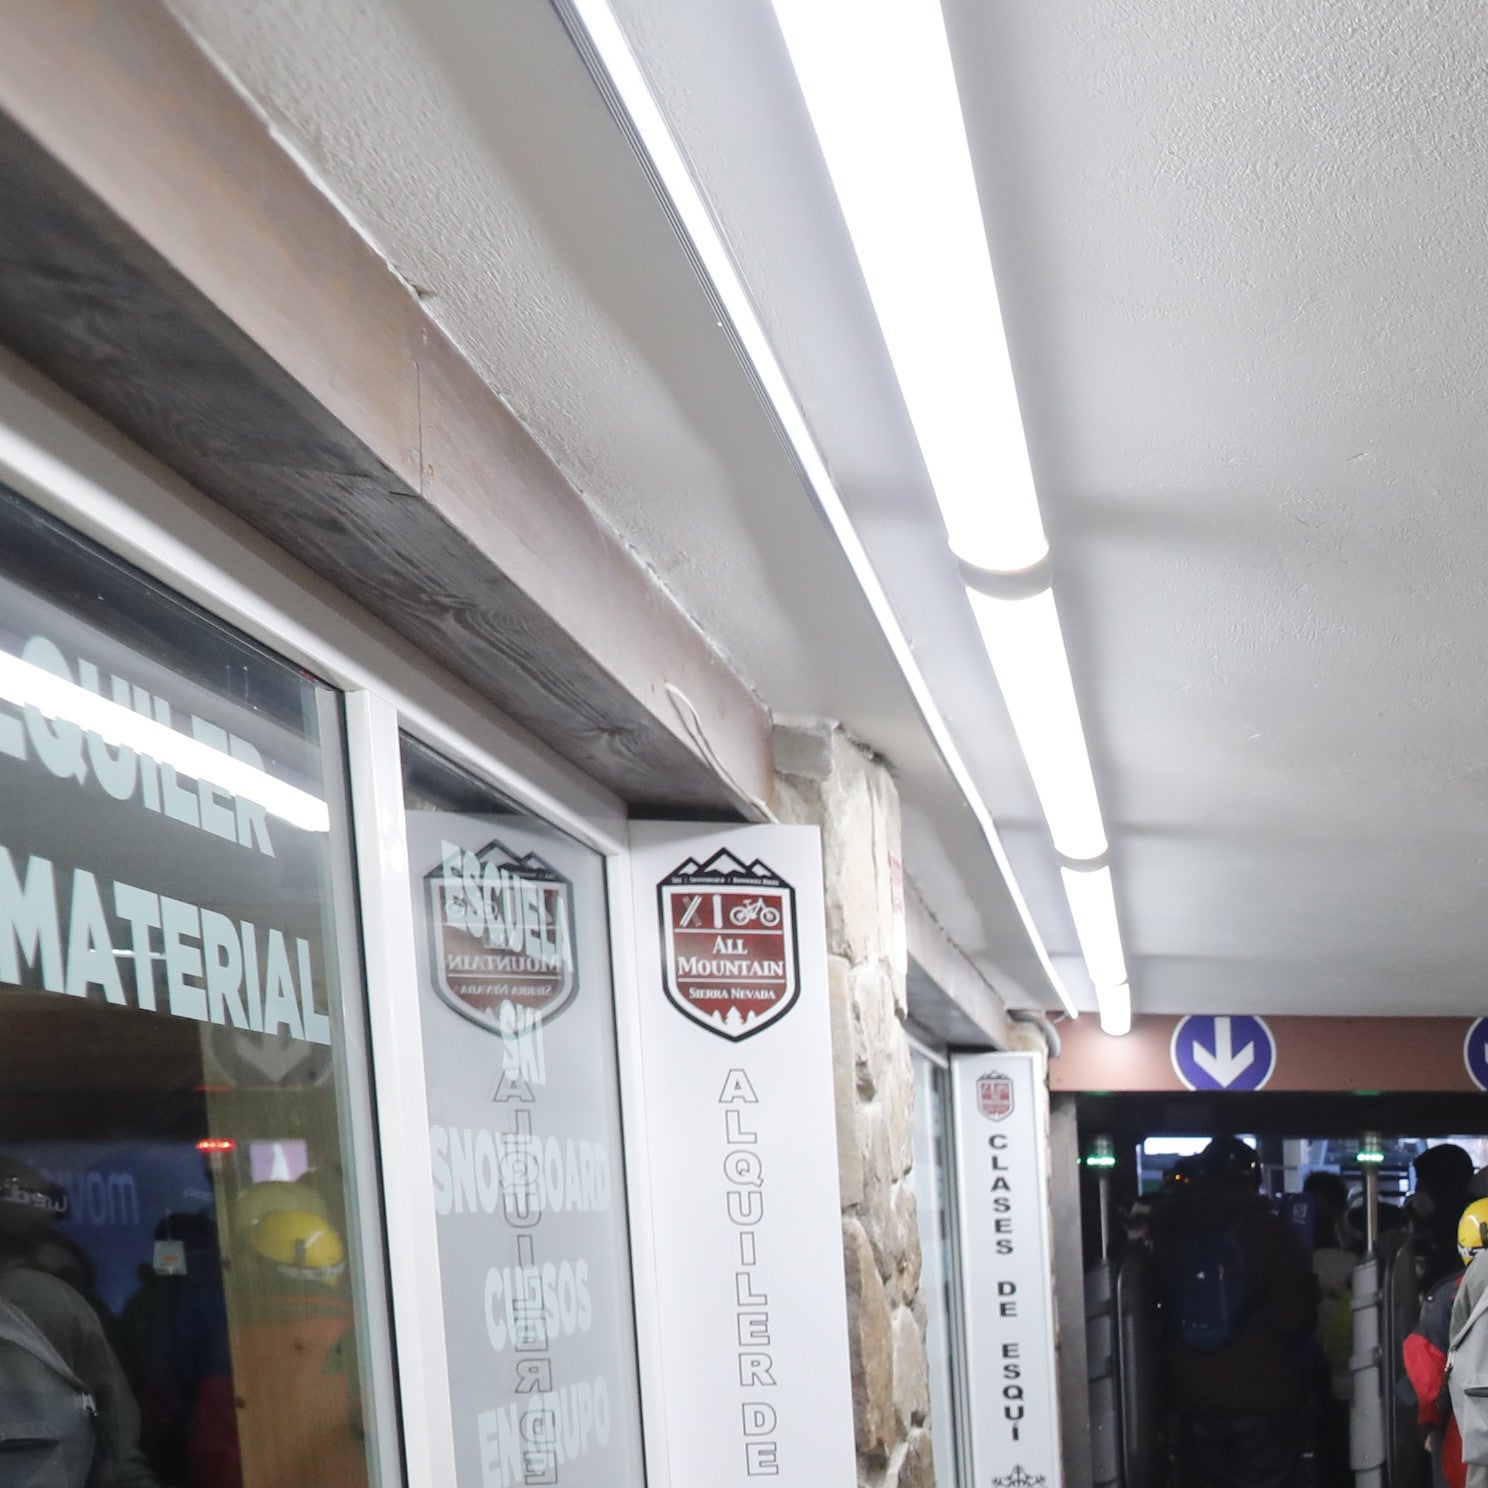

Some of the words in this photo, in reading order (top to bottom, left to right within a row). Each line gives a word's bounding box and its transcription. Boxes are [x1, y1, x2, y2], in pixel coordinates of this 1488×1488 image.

[441, 840, 574, 973] ESCUELA
[713, 936, 748, 955] ALL
[677, 956, 784, 977] MOUNTAIN
[688, 986, 729, 1000] SIERRA
[730, 987, 776, 1000] NEVADA
[498, 998, 546, 1086] SKI
[430, 1125, 610, 1216] SNOWBOARD
[987, 1133, 1014, 1256] CLASES
[718, 1068, 778, 1388] ALQUILER
[484, 1258, 592, 1353] CURSOS
[996, 1281, 1017, 1319] DE
[741, 1404, 780, 1476] DE
